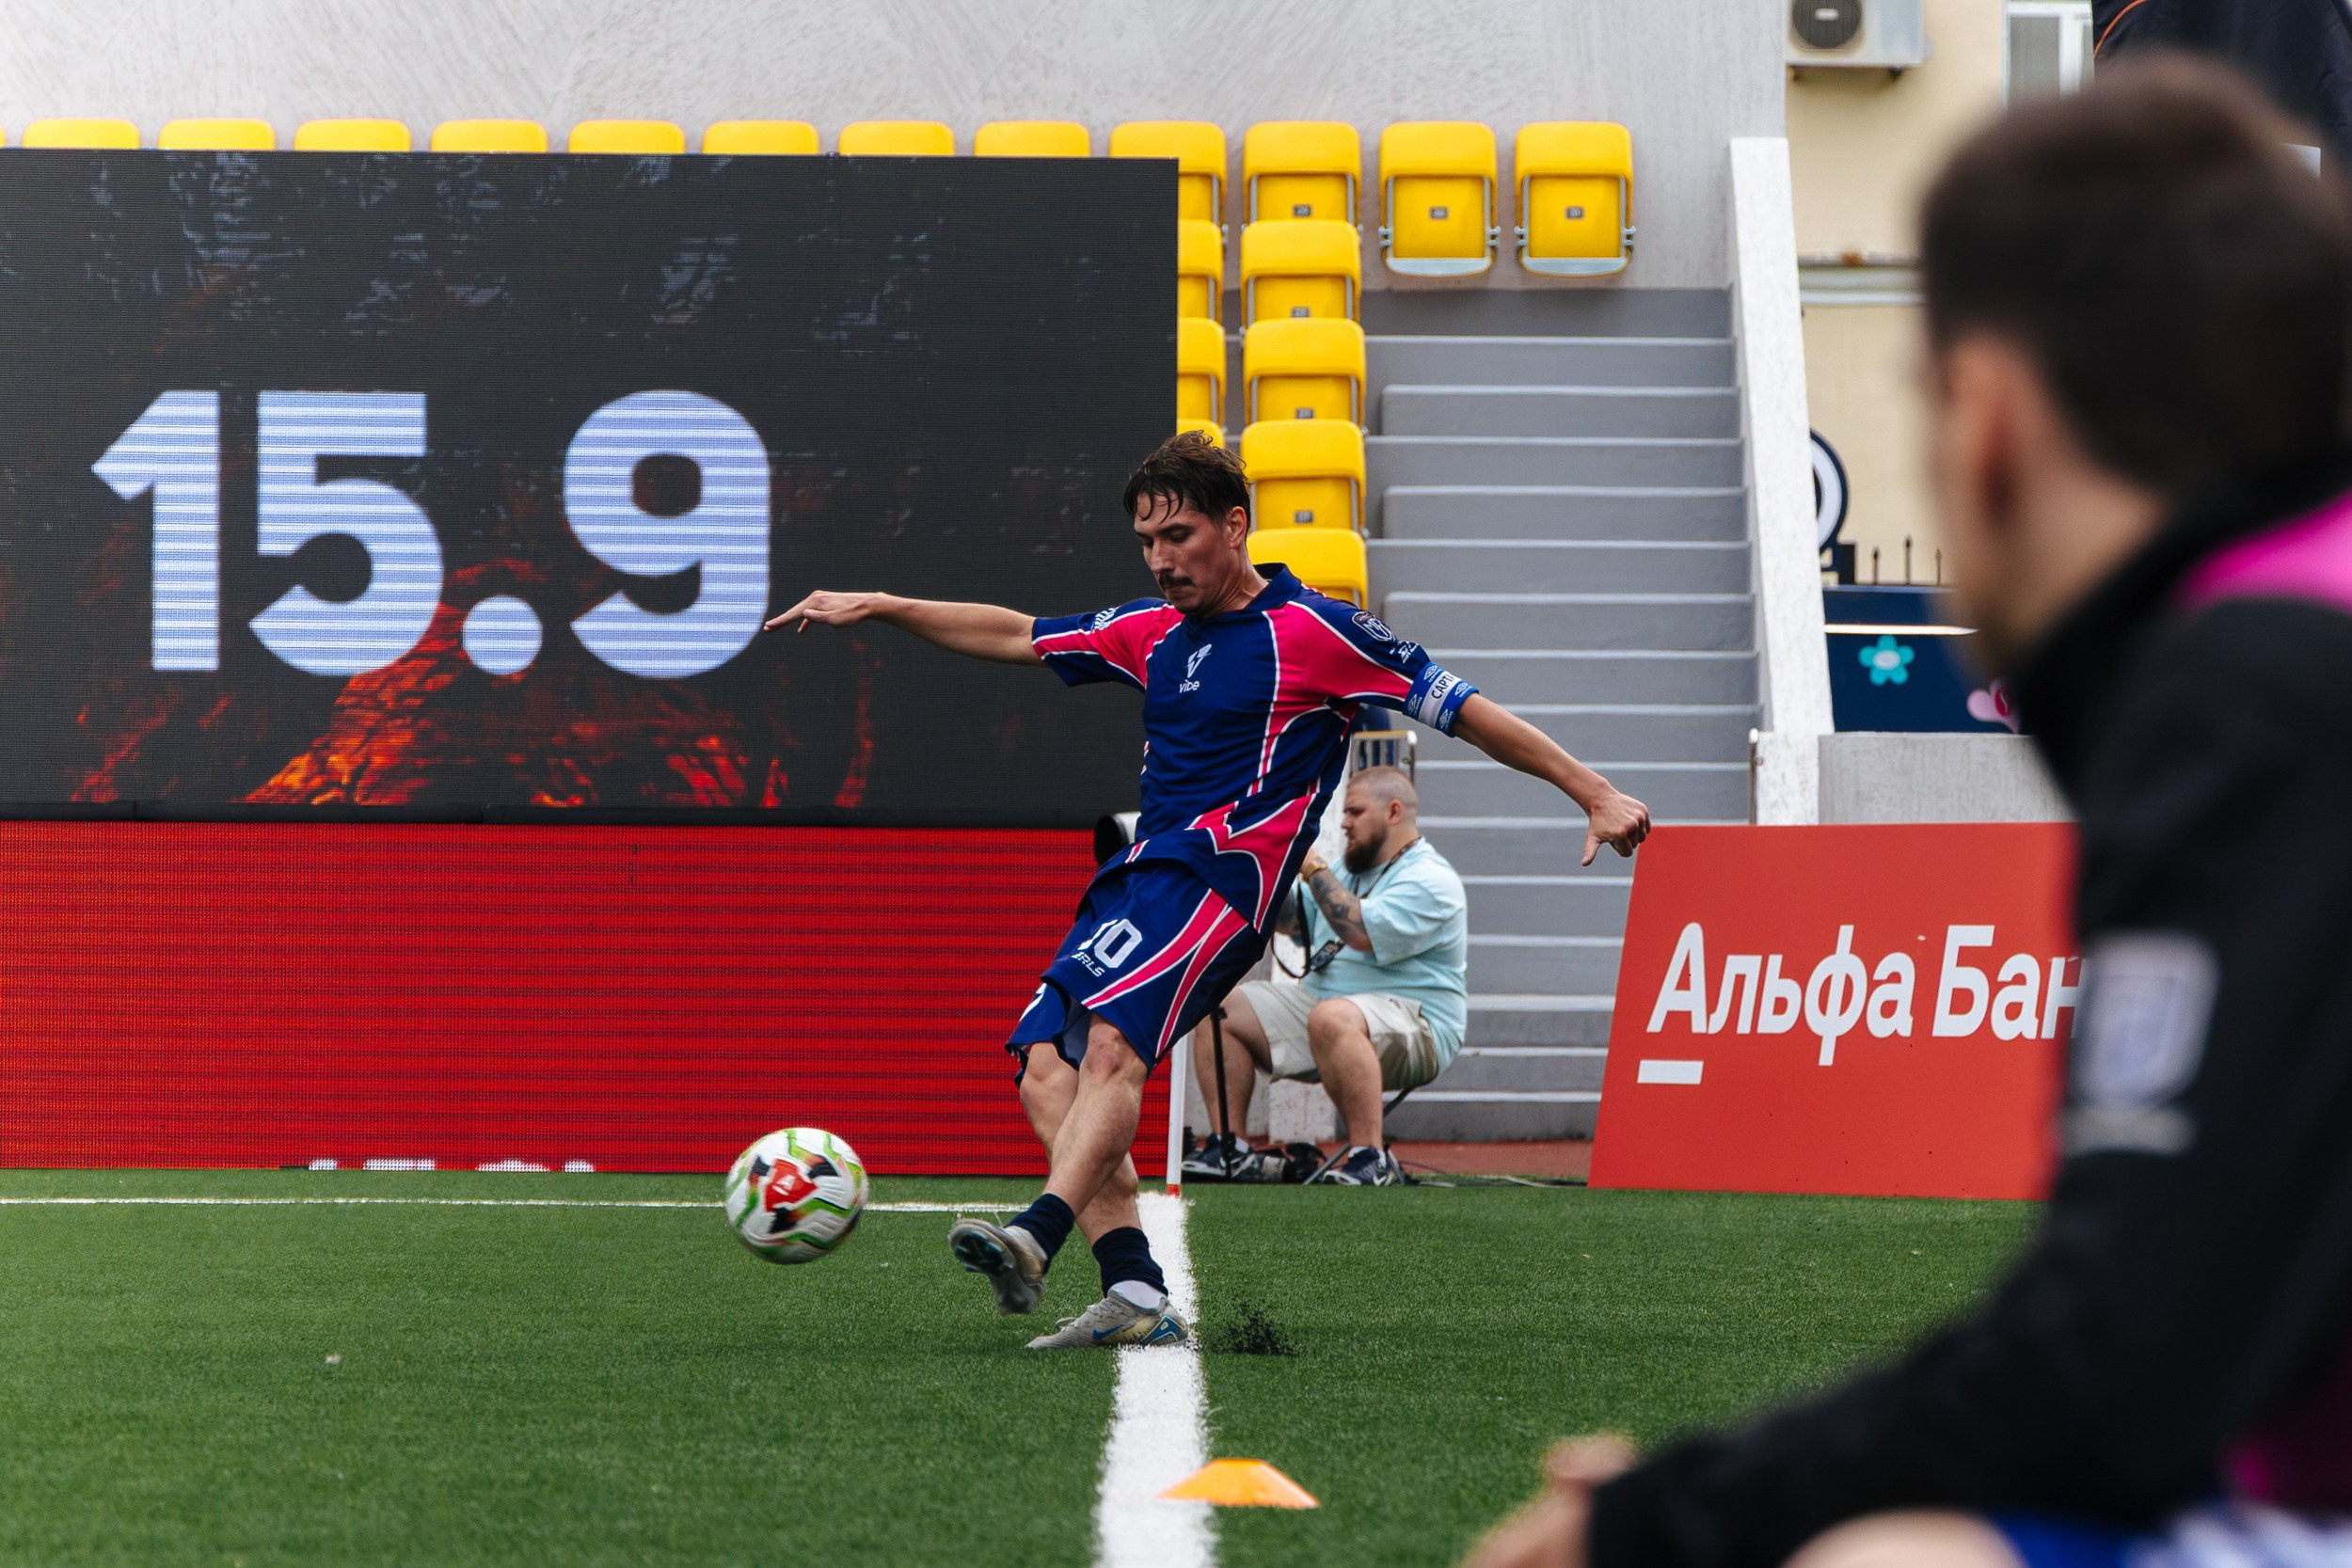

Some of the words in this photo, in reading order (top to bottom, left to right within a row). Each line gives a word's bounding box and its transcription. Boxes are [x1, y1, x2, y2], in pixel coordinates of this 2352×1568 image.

[91, 389, 771, 680] 15.9
[1431, 673, 1454, 700] CAPT
[1646, 922, 1915, 1066] Альфа
